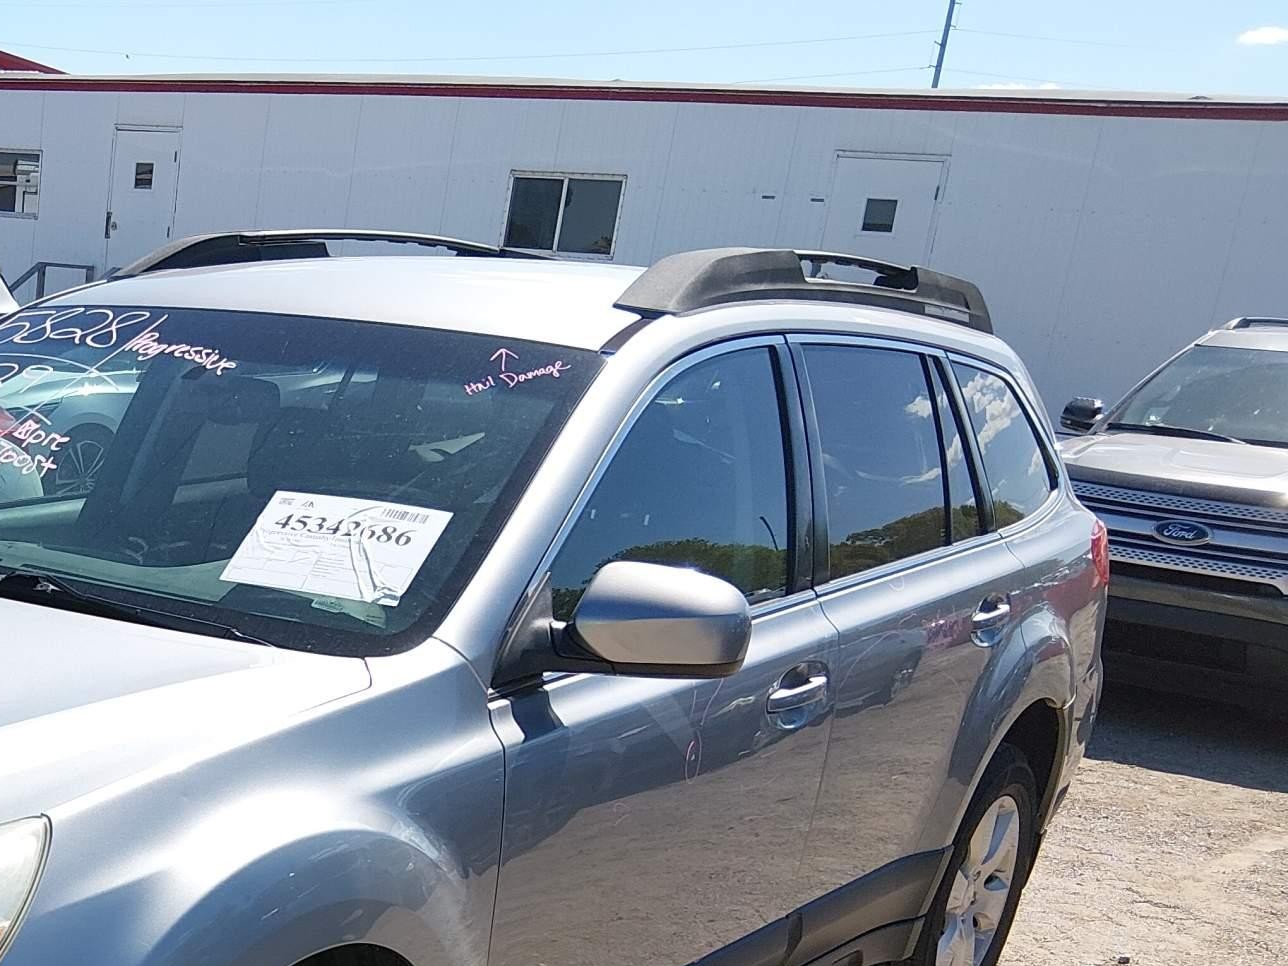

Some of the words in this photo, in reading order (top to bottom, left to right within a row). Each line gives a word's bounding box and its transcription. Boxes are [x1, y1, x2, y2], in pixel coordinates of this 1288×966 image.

[499, 361, 572, 388] Damage
[274, 513, 417, 547] 45342686
[1162, 524, 1199, 539] Ford
